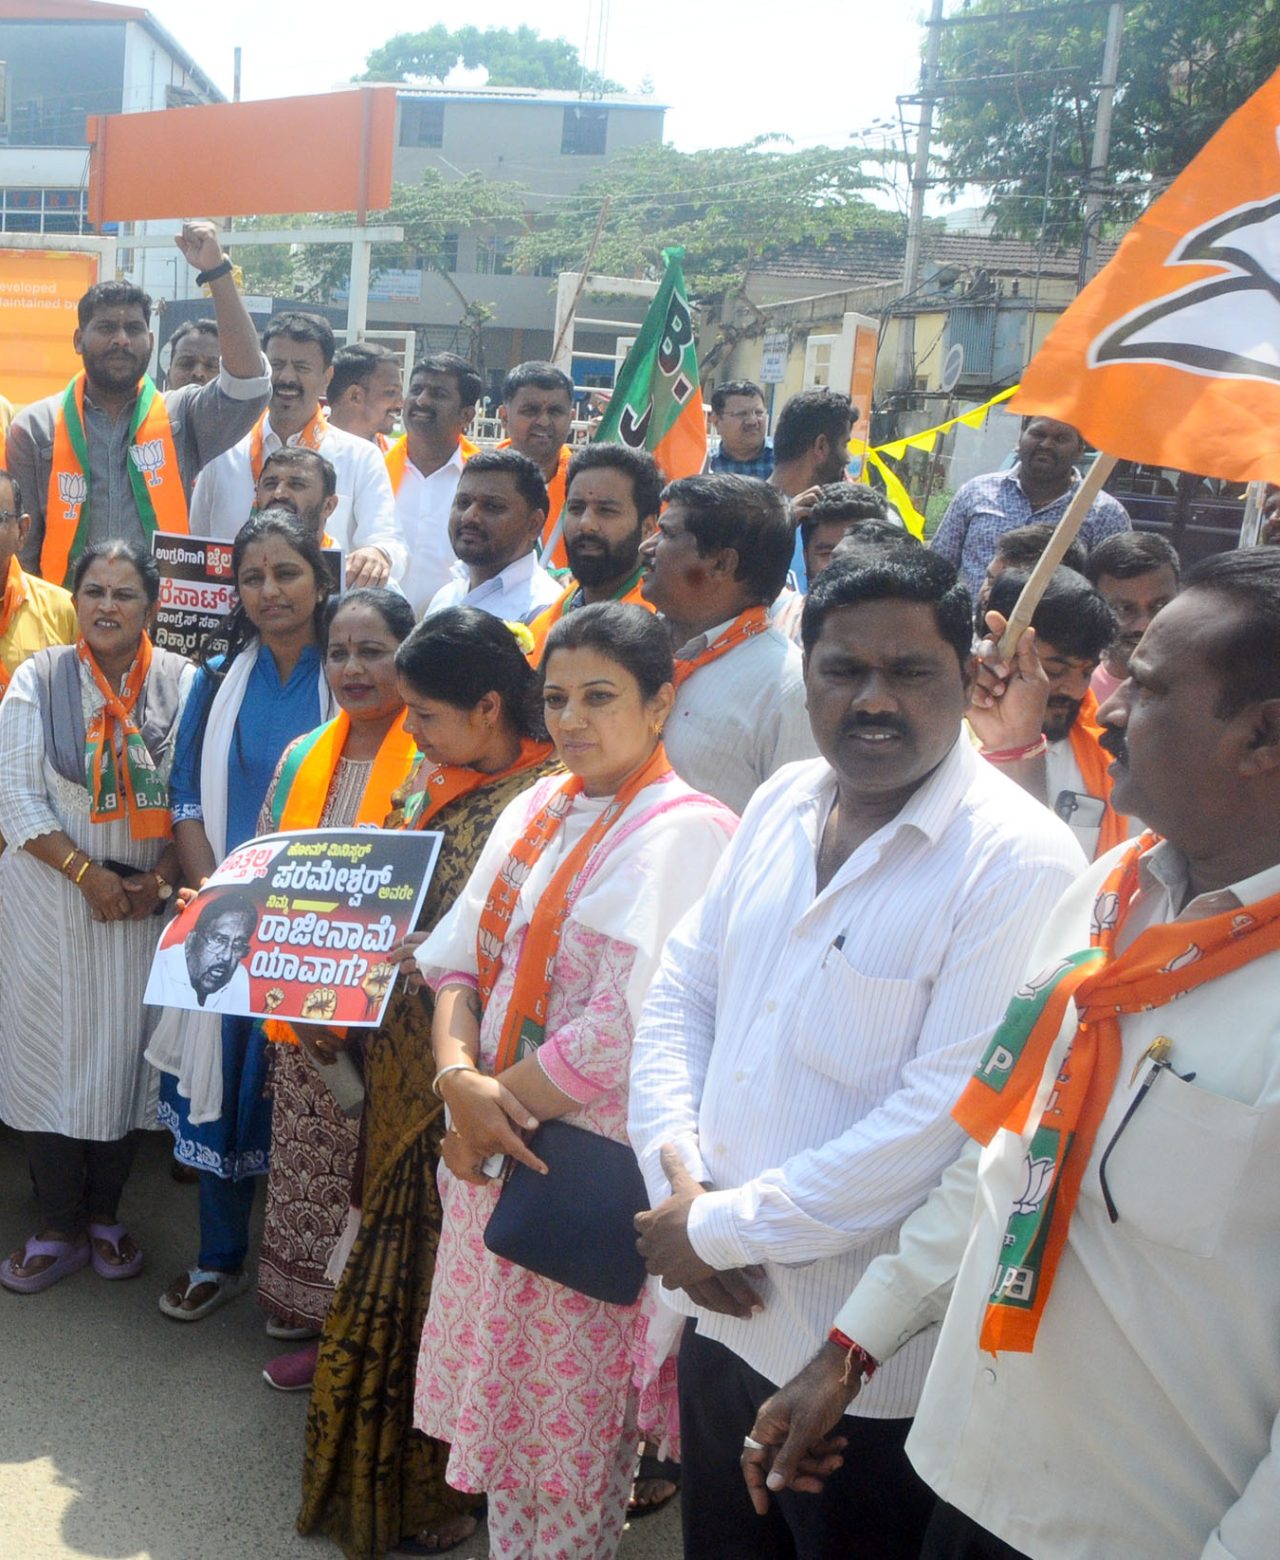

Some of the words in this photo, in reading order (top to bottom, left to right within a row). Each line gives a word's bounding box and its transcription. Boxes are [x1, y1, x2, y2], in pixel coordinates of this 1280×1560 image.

[271, 859, 395, 908] ಪರಮೇಶ್ವರ್
[257, 911, 396, 951] ರಾಜೀನಾಮೆ
[248, 948, 368, 988] ಯಾವಾಗ?
